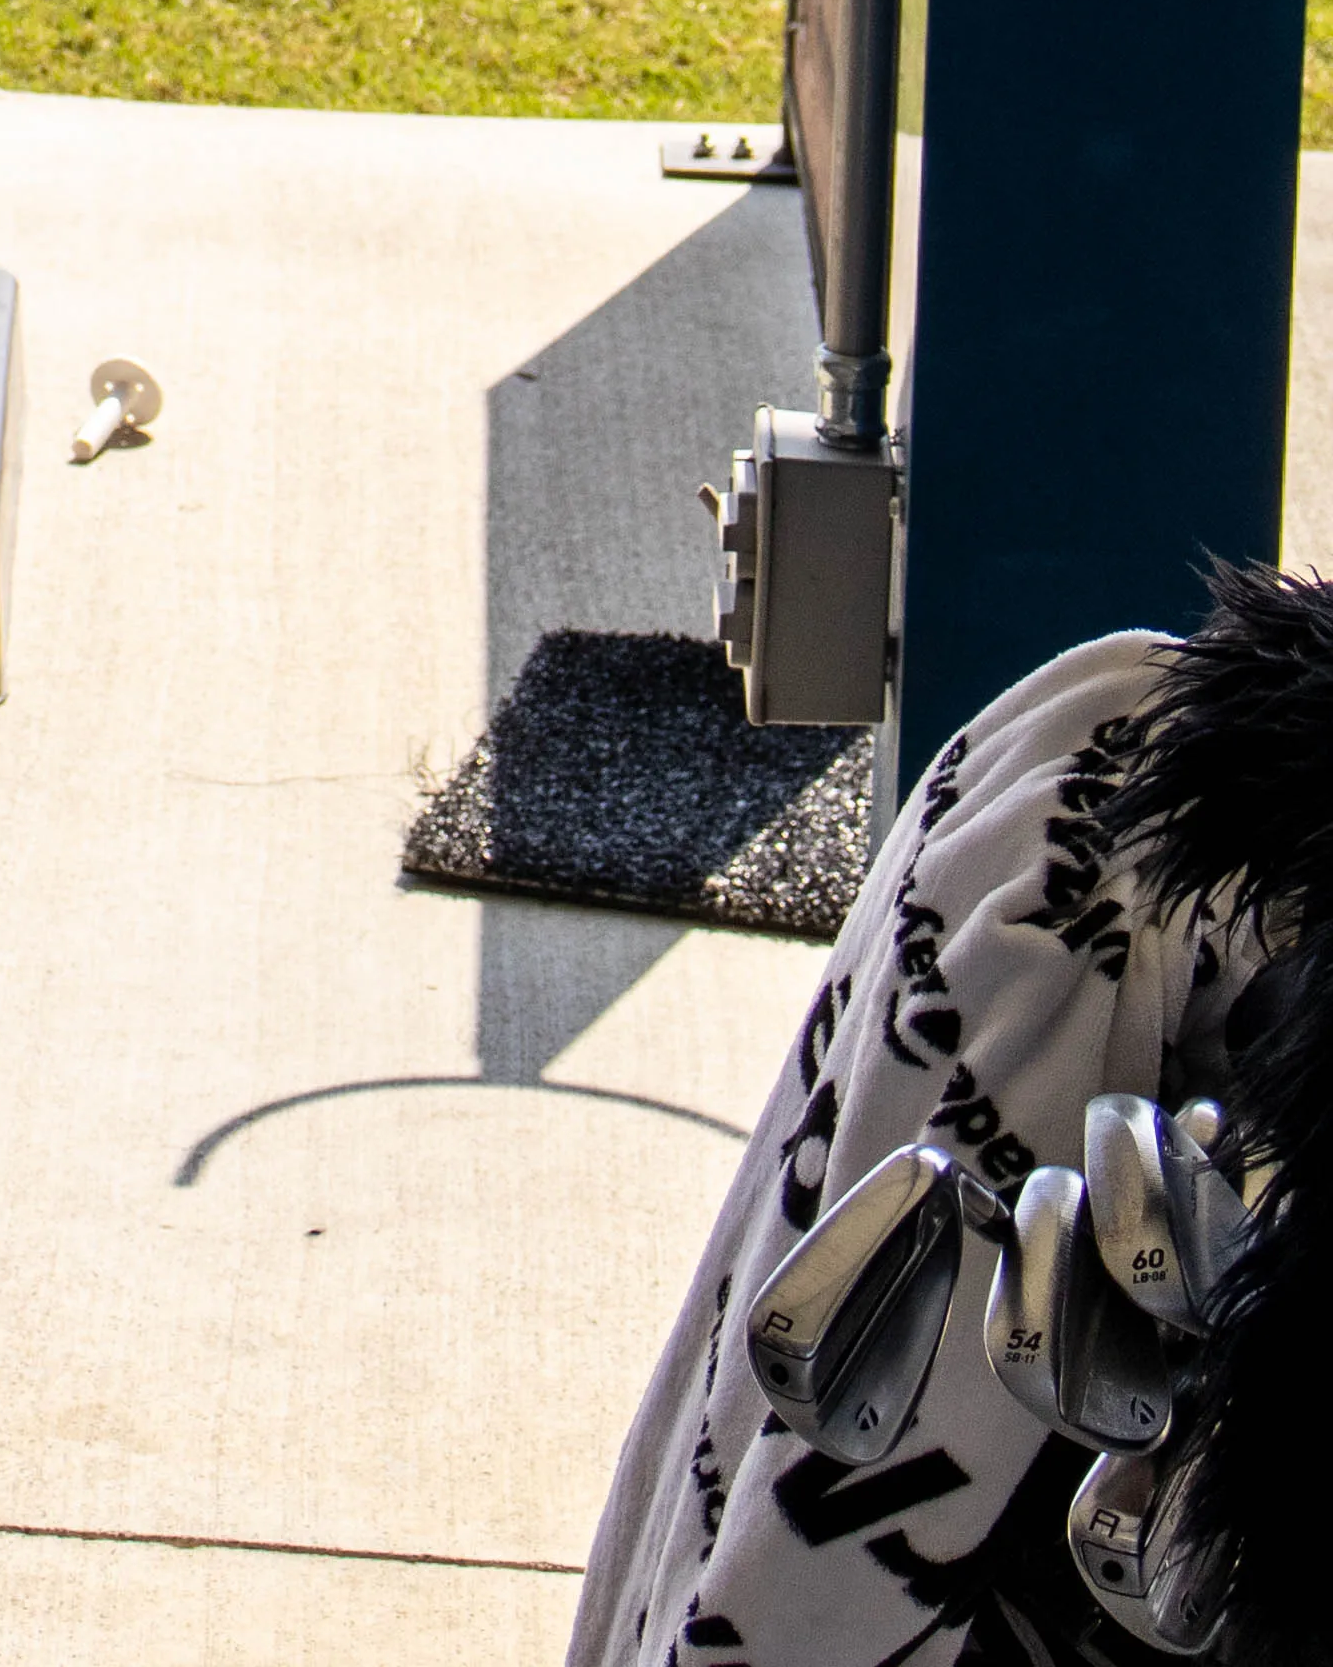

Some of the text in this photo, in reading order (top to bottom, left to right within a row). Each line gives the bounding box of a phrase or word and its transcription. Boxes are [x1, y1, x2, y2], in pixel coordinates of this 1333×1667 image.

[1132, 1248, 1165, 1271] 60
[763, 1310, 794, 1334] P
[1007, 1328, 1043, 1352] 54
[1089, 1508, 1120, 1539] A
